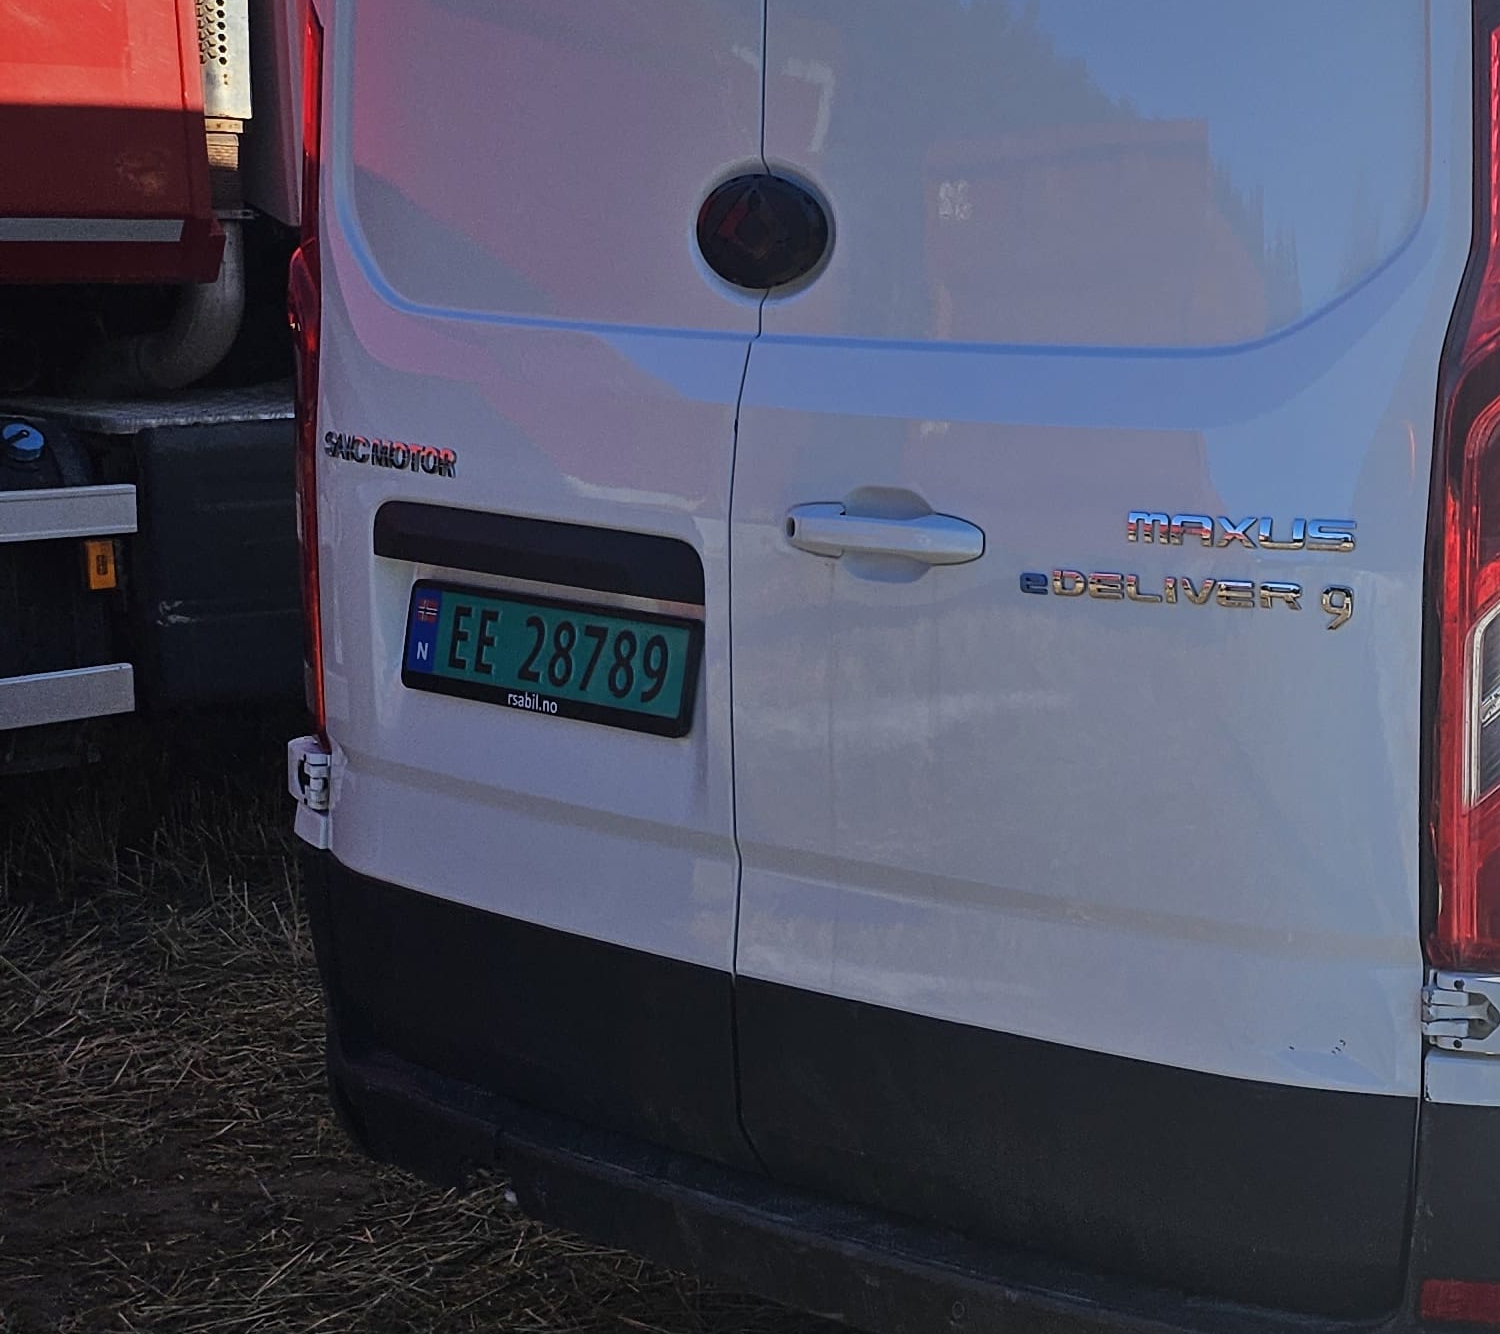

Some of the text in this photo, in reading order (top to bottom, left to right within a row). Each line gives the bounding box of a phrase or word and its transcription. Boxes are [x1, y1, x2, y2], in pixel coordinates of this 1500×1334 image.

[324, 430, 457, 479] SAIC MOTOR
[1126, 510, 1357, 553] MAXUS
[1320, 584, 1354, 631] 9
[416, 641, 429, 661] N
[448, 604, 670, 704] EE 28789
[507, 691, 558, 715] rsabil.no
